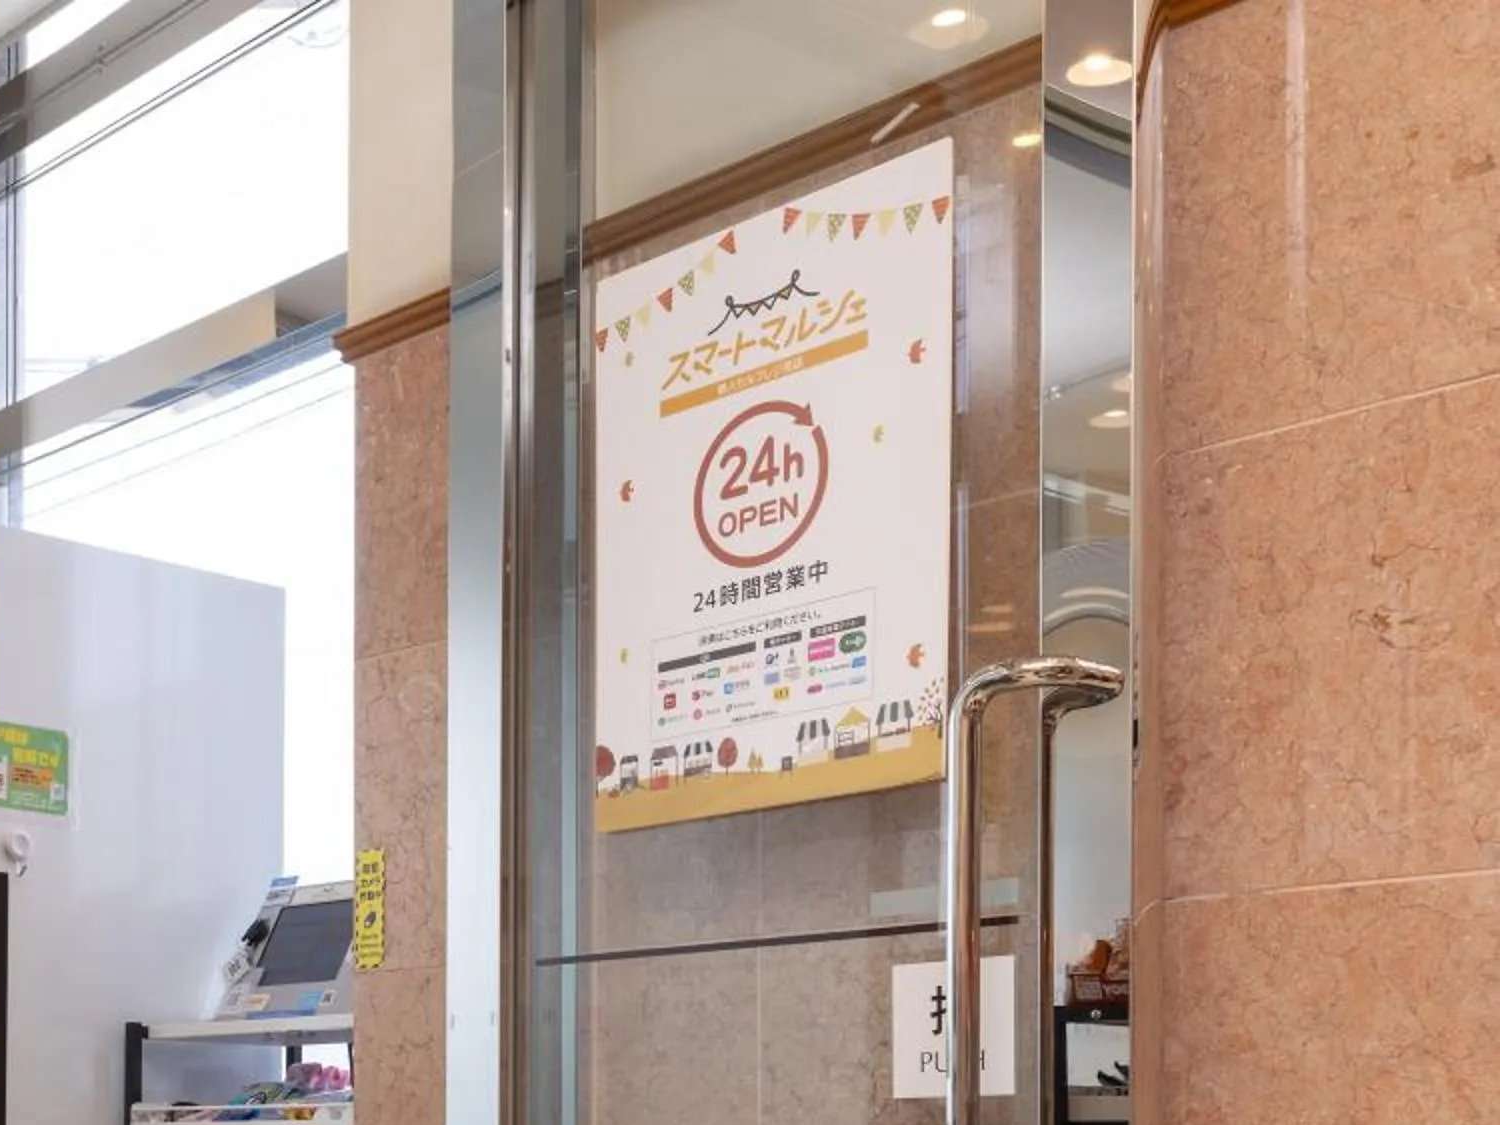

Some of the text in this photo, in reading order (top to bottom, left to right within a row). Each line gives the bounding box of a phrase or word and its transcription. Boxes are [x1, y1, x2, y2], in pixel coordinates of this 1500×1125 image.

[661, 289, 868, 390] スマートマルシェ
[719, 436, 804, 500] 24h
[717, 493, 799, 537] OPEN
[693, 559, 828, 613] 24時間営業中
[920, 1049, 985, 1073] PUH
